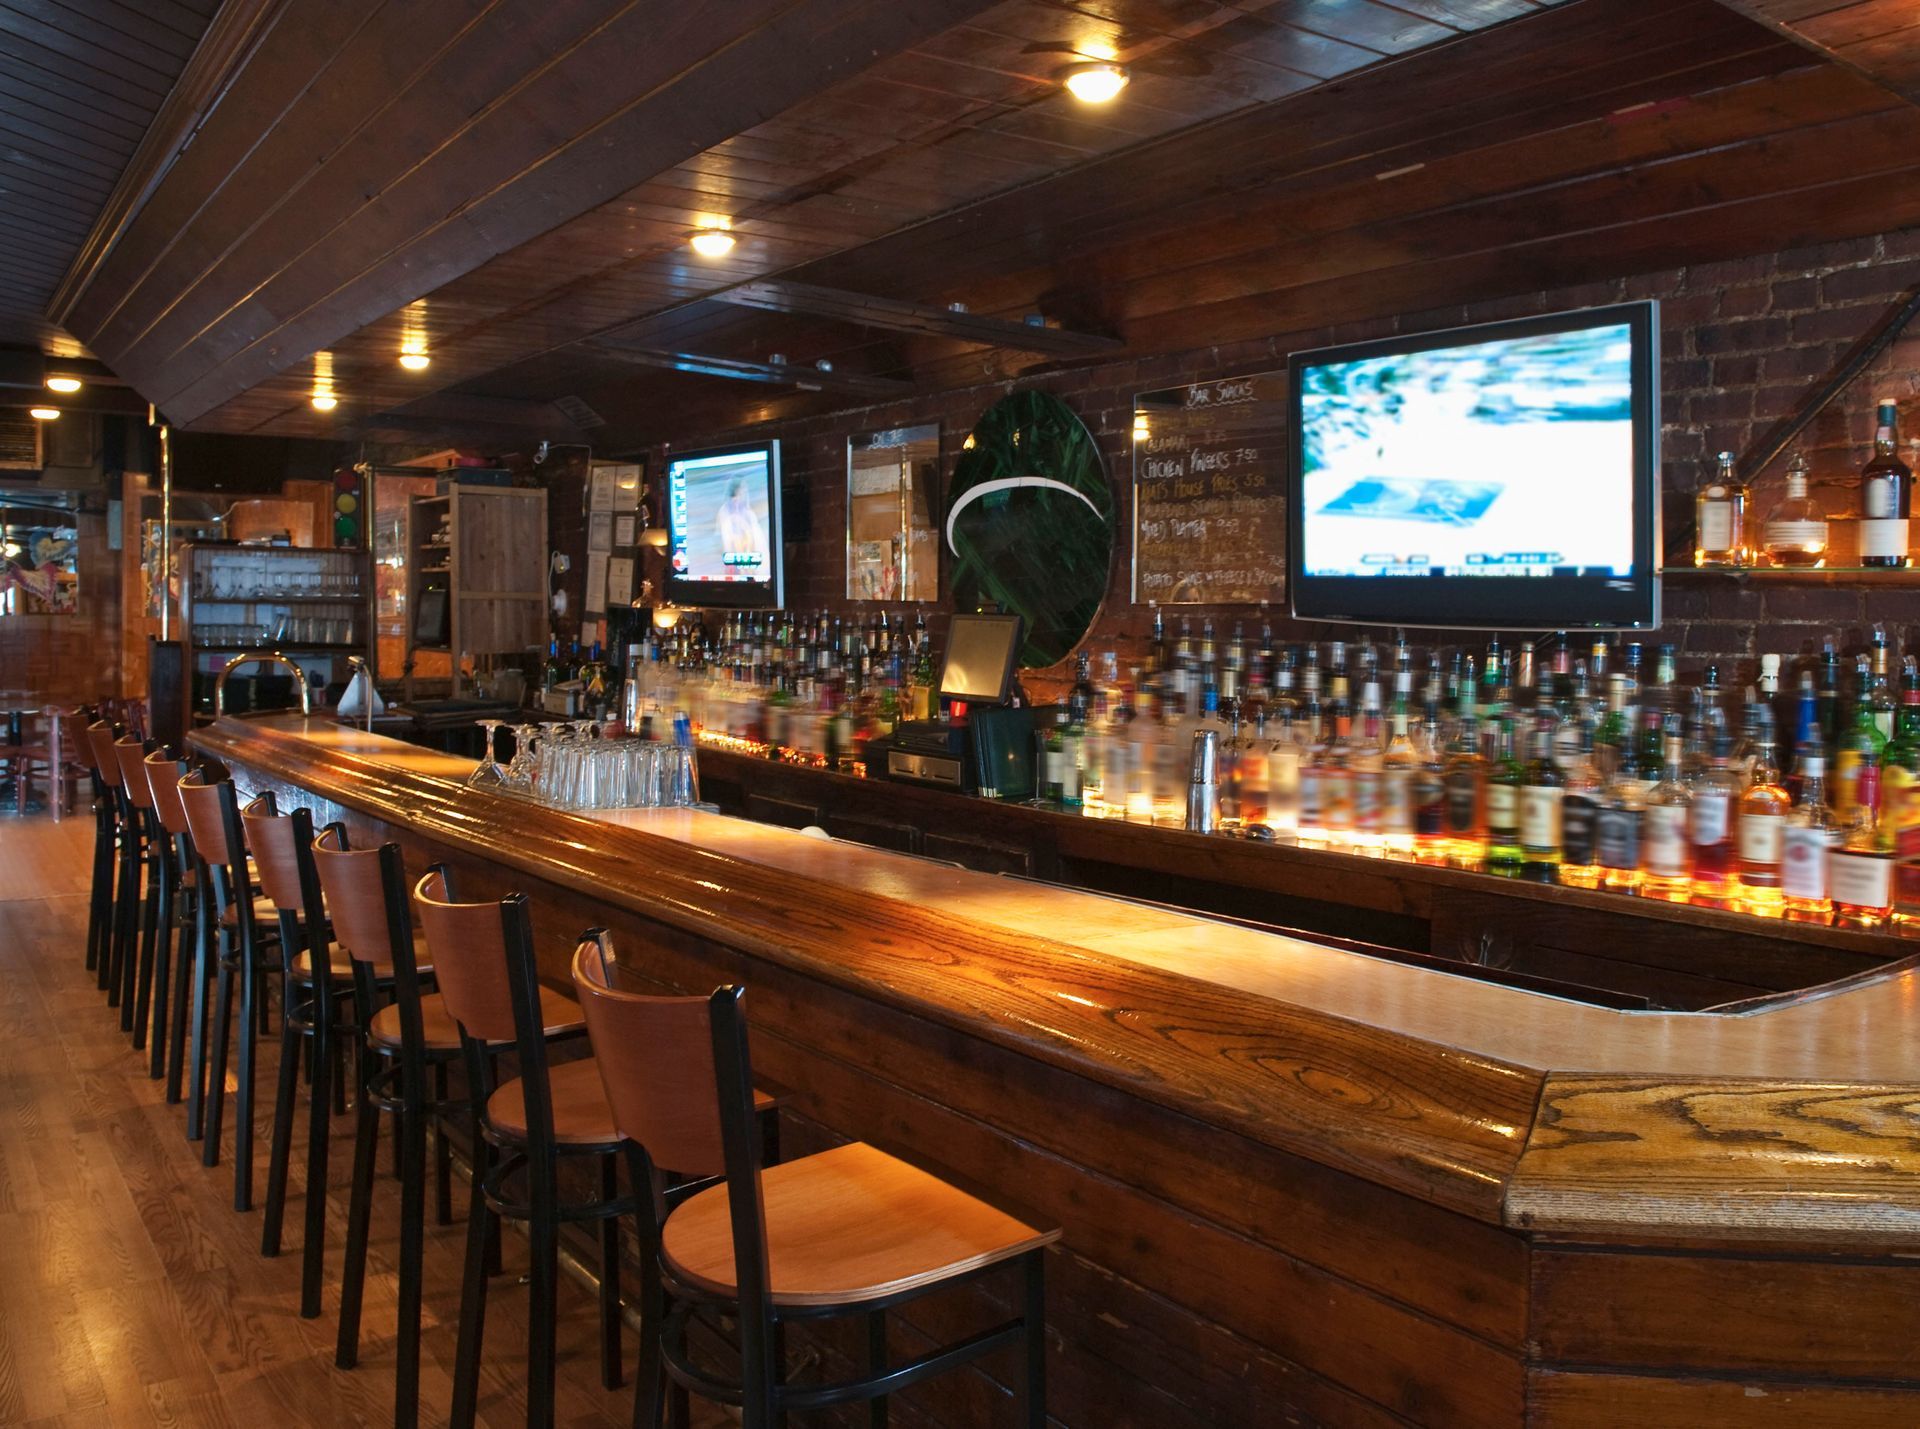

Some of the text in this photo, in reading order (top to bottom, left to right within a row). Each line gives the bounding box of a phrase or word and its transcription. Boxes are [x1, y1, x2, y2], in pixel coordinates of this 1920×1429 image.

[1187, 381, 1254, 407] BAR SNACKS
[1140, 457, 1184, 479] CHICKEN
[1190, 448, 1230, 474] FINGERS
